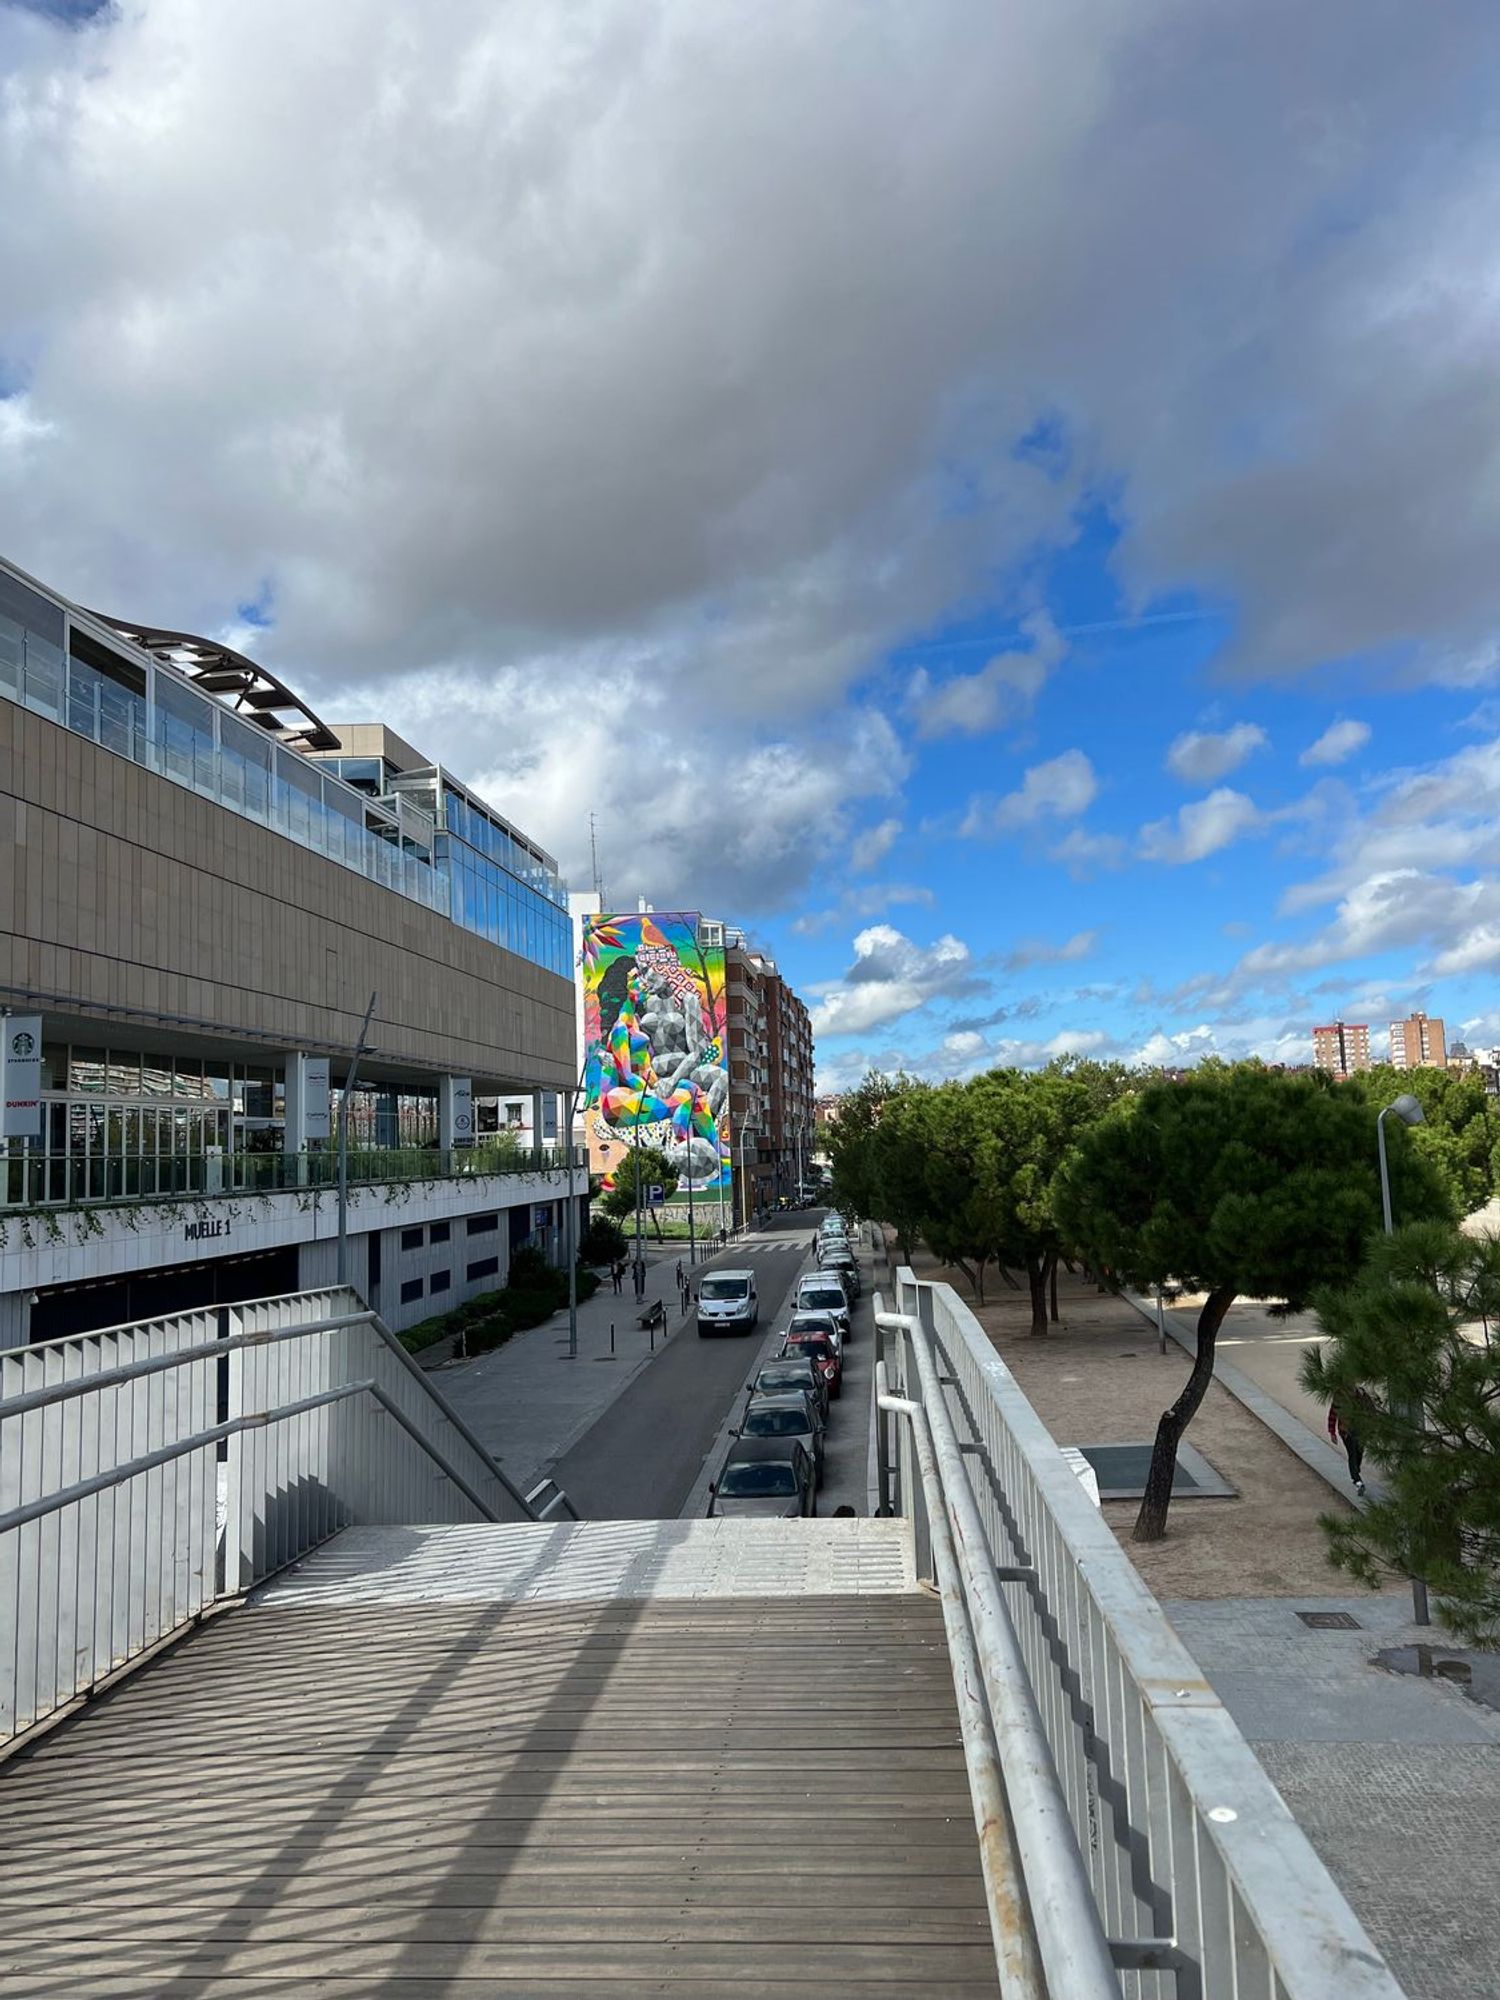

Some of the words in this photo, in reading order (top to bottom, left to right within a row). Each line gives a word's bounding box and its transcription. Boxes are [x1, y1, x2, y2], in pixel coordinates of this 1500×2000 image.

[649, 1185, 663, 1200] P
[185, 1220, 222, 1241] MUELLE
[225, 1219, 231, 1236] 1
